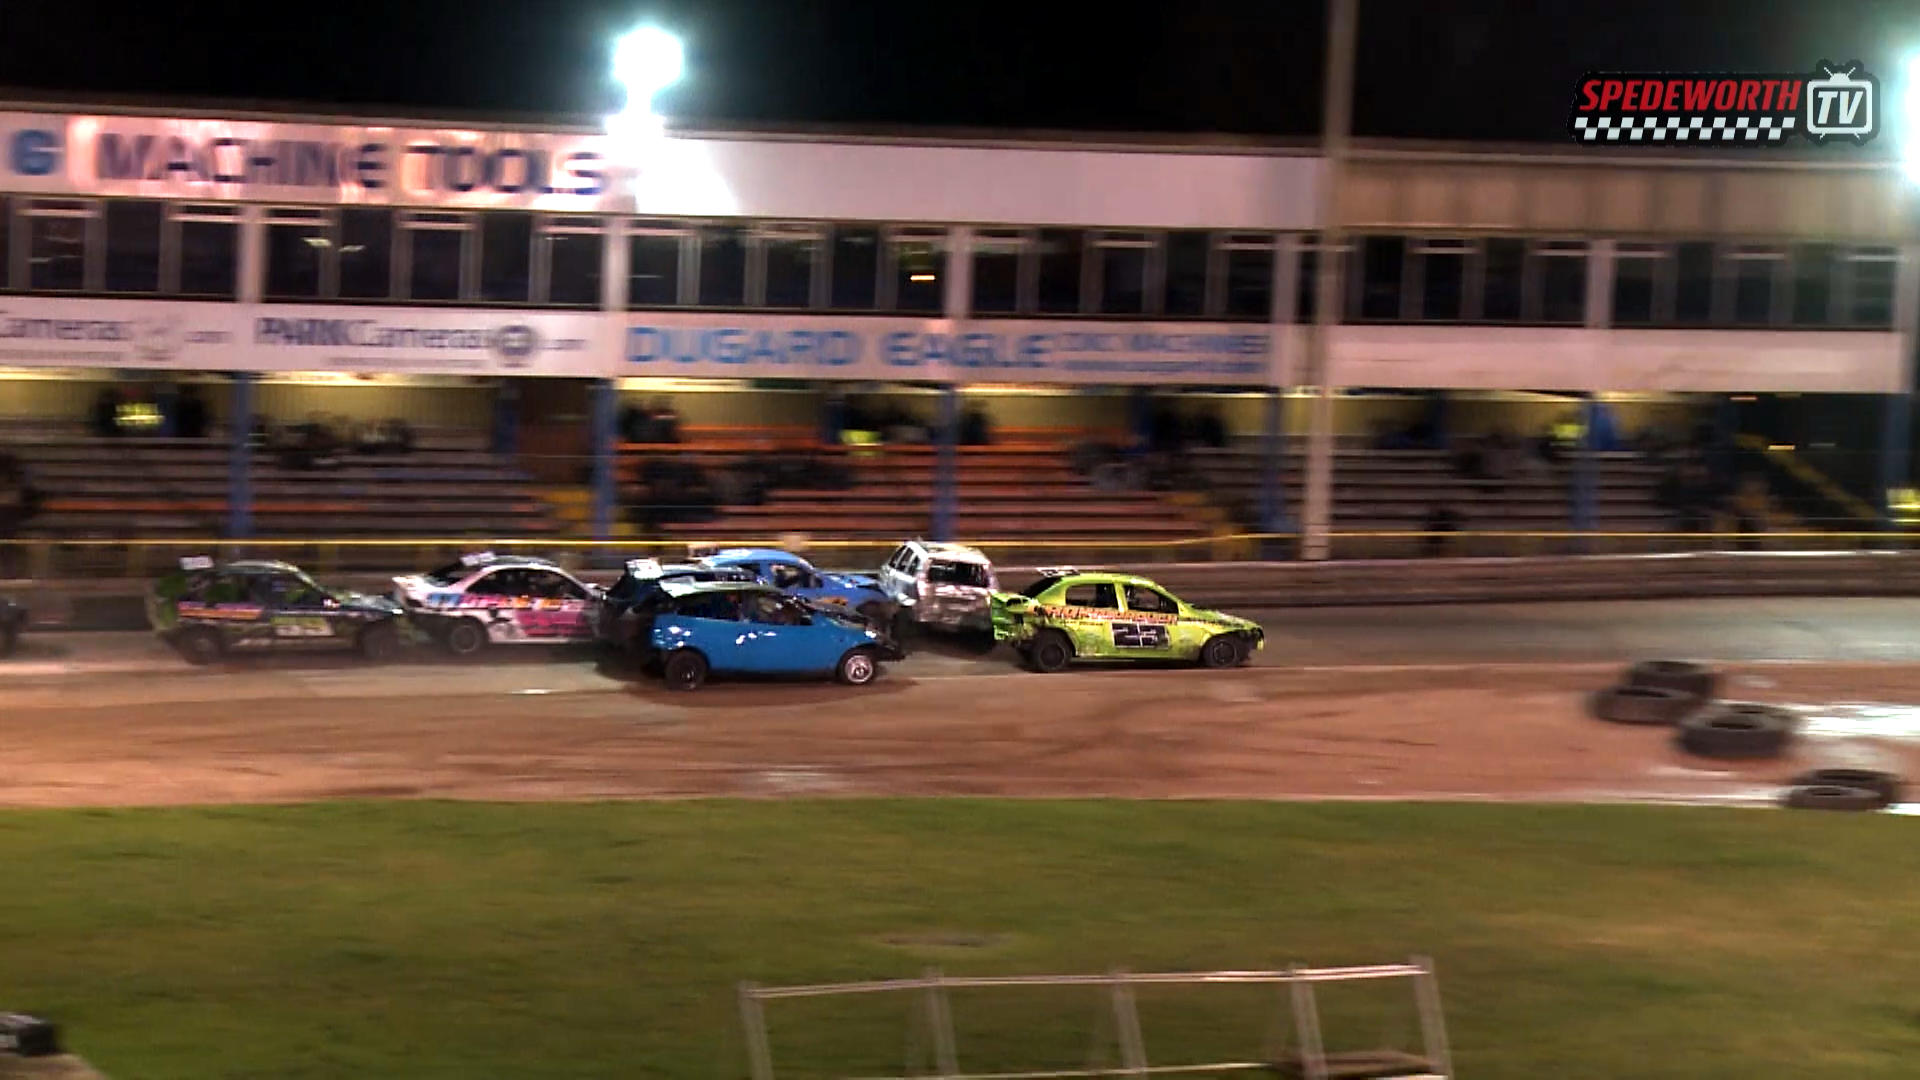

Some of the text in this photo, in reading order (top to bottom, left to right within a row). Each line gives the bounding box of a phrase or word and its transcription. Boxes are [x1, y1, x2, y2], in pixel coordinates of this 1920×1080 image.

[96, 132, 390, 188] MACHINE
[403, 145, 607, 195] TOOLS
[626, 326, 1052, 369] DUGARD EAGLE
